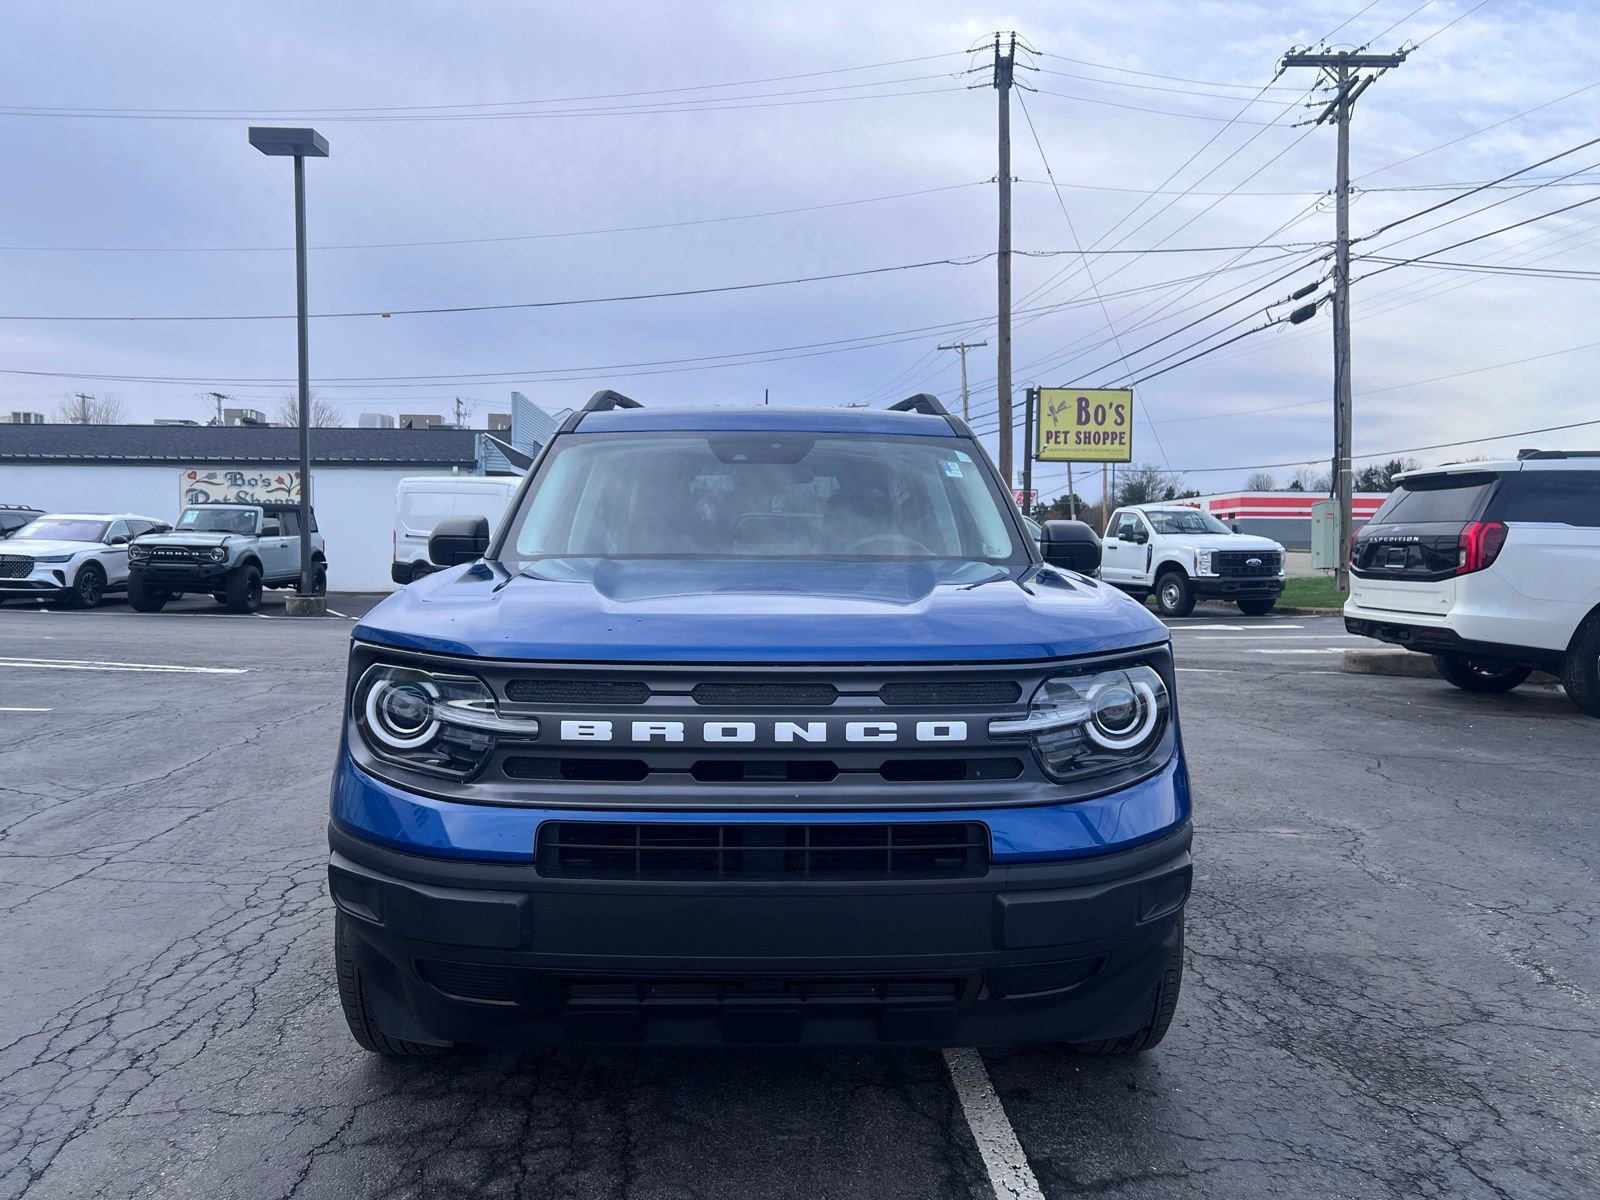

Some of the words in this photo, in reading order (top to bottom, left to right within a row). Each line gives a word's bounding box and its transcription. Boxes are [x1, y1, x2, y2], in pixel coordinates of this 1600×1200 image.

[1045, 430, 1070, 444] PET
[1075, 430, 1126, 445] SHOPPE
[224, 471, 272, 488] Bo's
[560, 720, 968, 742] BRONCO
